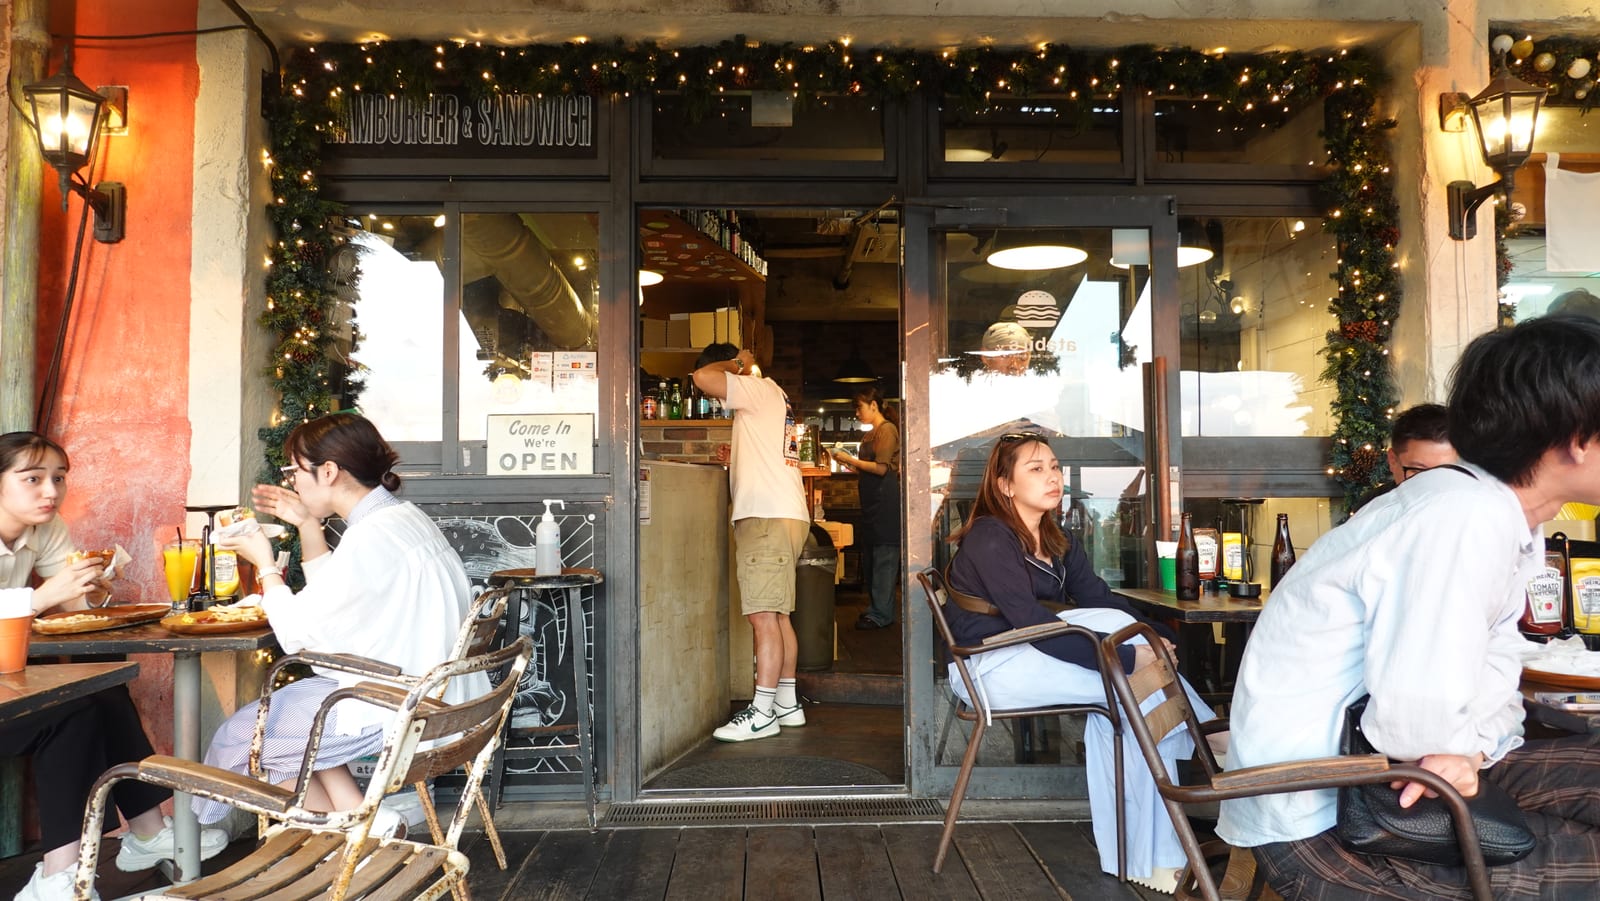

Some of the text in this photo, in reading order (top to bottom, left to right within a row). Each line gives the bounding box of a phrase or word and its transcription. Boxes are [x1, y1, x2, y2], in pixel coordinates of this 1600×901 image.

[326, 94, 592, 147] AMBURGER & SANDWICH
[509, 420, 571, 436] Come In
[524, 438, 556, 448] We're
[499, 453, 577, 471] OPEN
[1533, 583, 1559, 591] TOMATO
